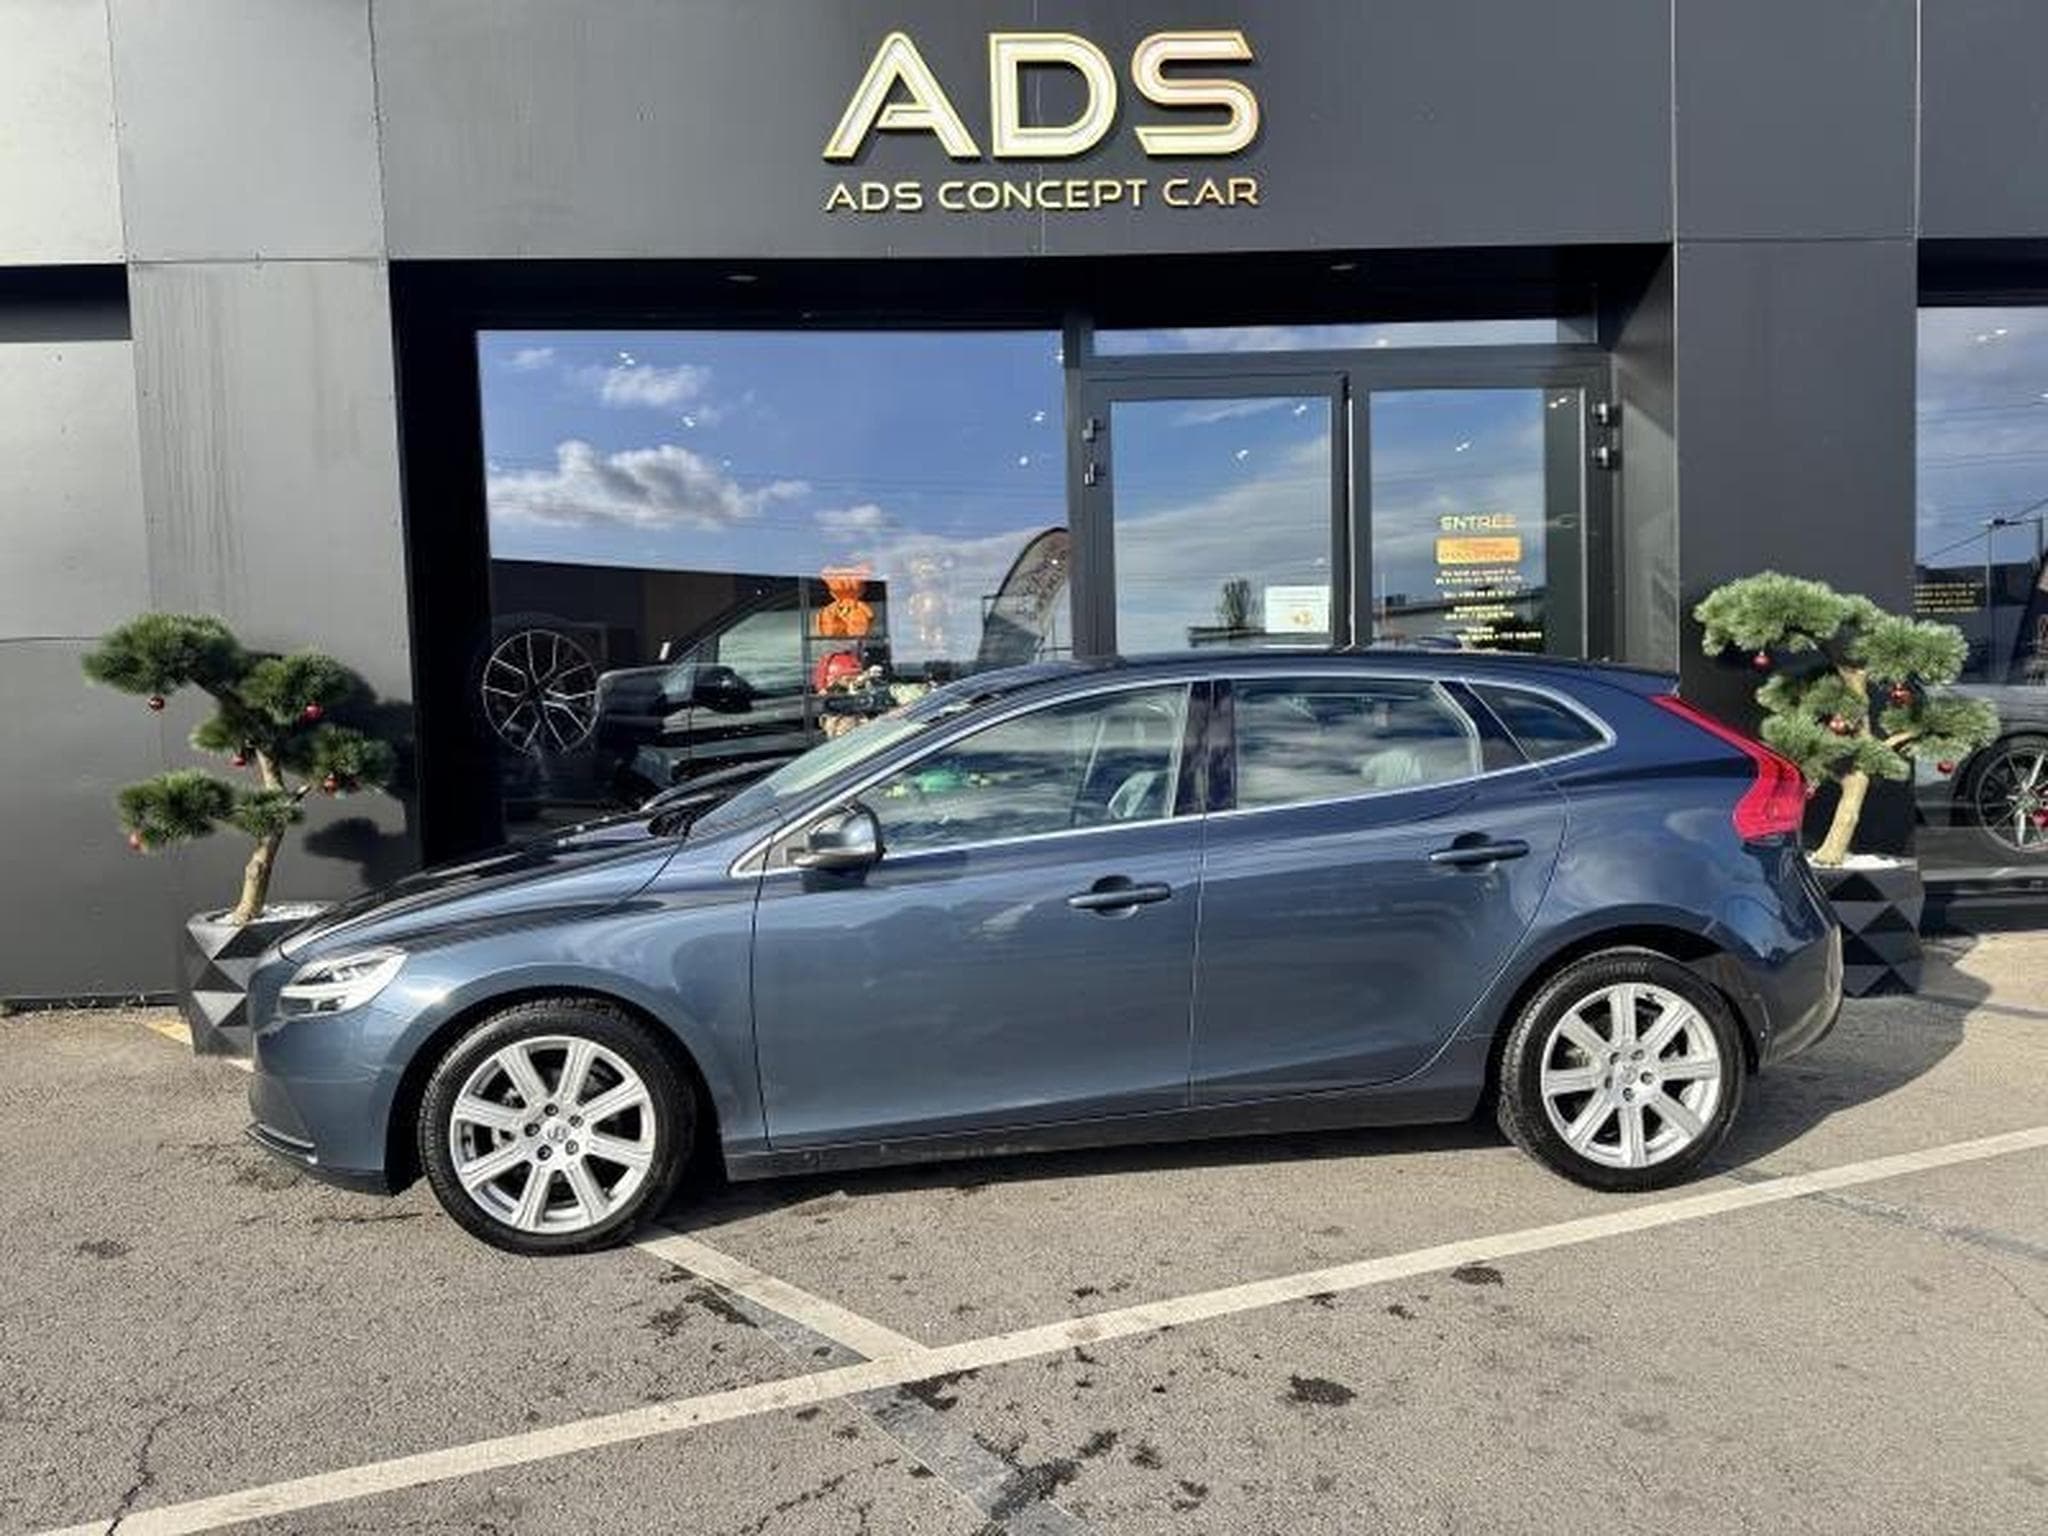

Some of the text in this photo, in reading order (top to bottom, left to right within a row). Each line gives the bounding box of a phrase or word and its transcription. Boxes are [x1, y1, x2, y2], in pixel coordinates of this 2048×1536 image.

[823, 30, 1260, 158] ADS
[825, 178, 1260, 211] ADS CONCEPT CAR
